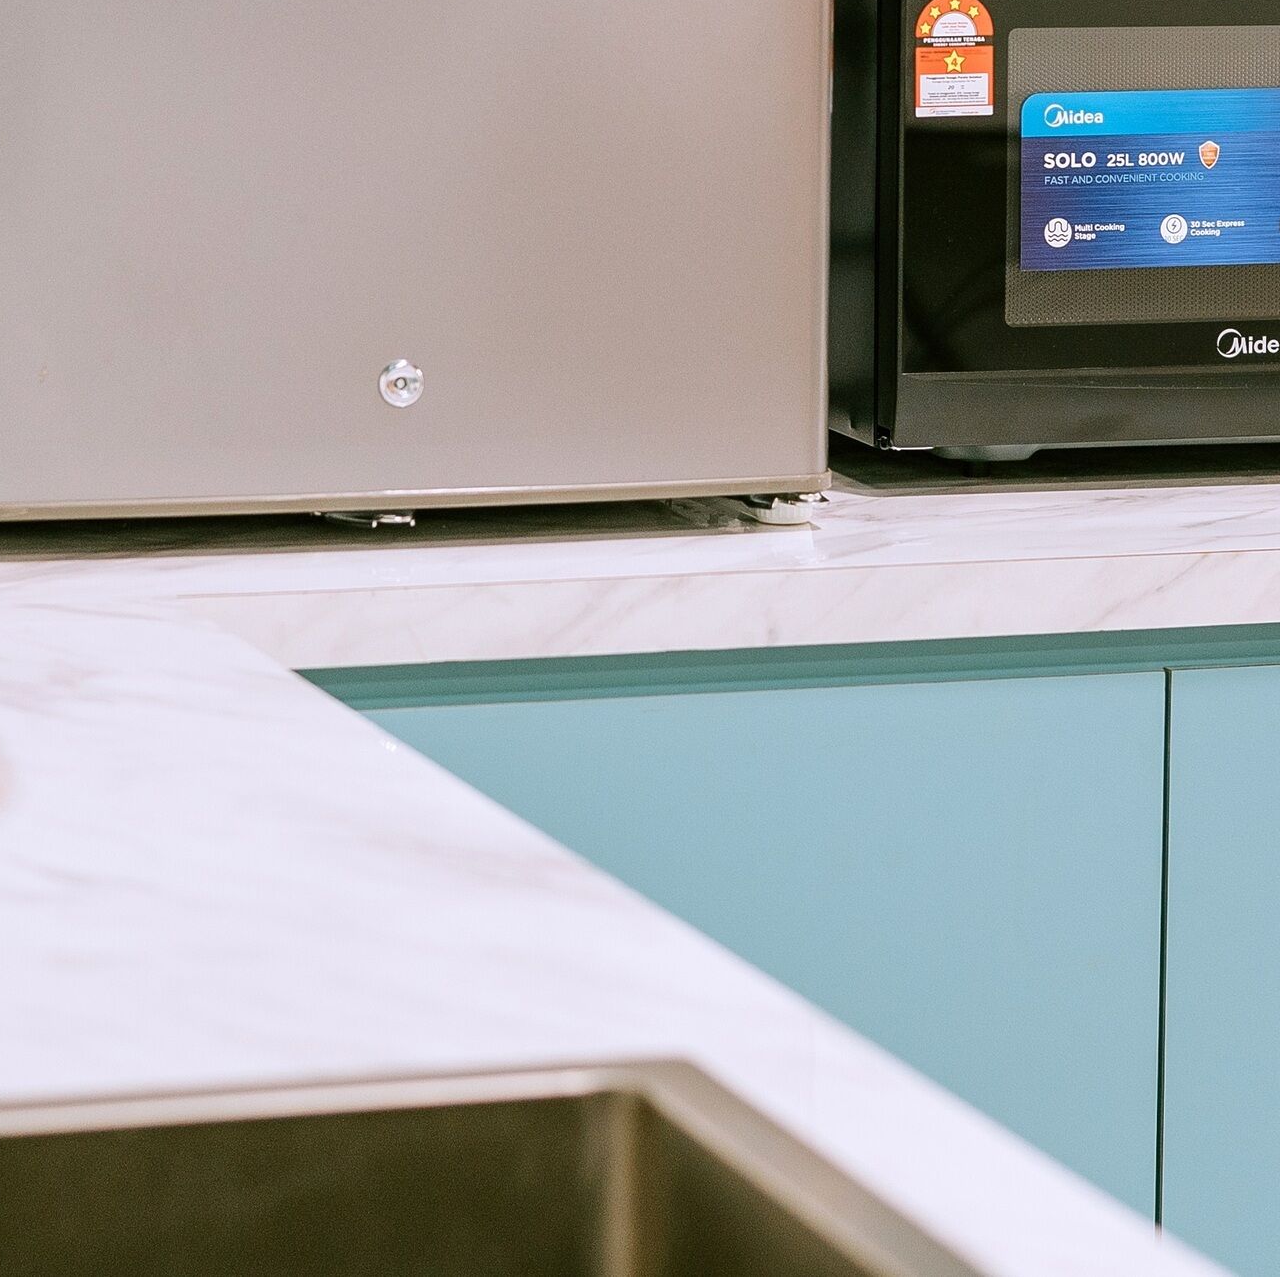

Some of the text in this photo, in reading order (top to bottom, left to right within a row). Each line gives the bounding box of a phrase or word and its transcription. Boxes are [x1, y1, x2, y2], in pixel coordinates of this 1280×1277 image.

[951, 58, 958, 67] 4
[1044, 104, 1104, 128] Midea
[1044, 152, 1097, 168] SOLO
[1106, 153, 1134, 167] 25L
[1138, 152, 1185, 166] 800W
[1045, 172, 1204, 185] FAST AND CONVENIENT COOKING
[1074, 223, 1125, 233] Multi Cooking
[1216, 220, 1245, 228] Express
[1074, 232, 1096, 241] Stage
[1190, 229, 1221, 237] Cooking
